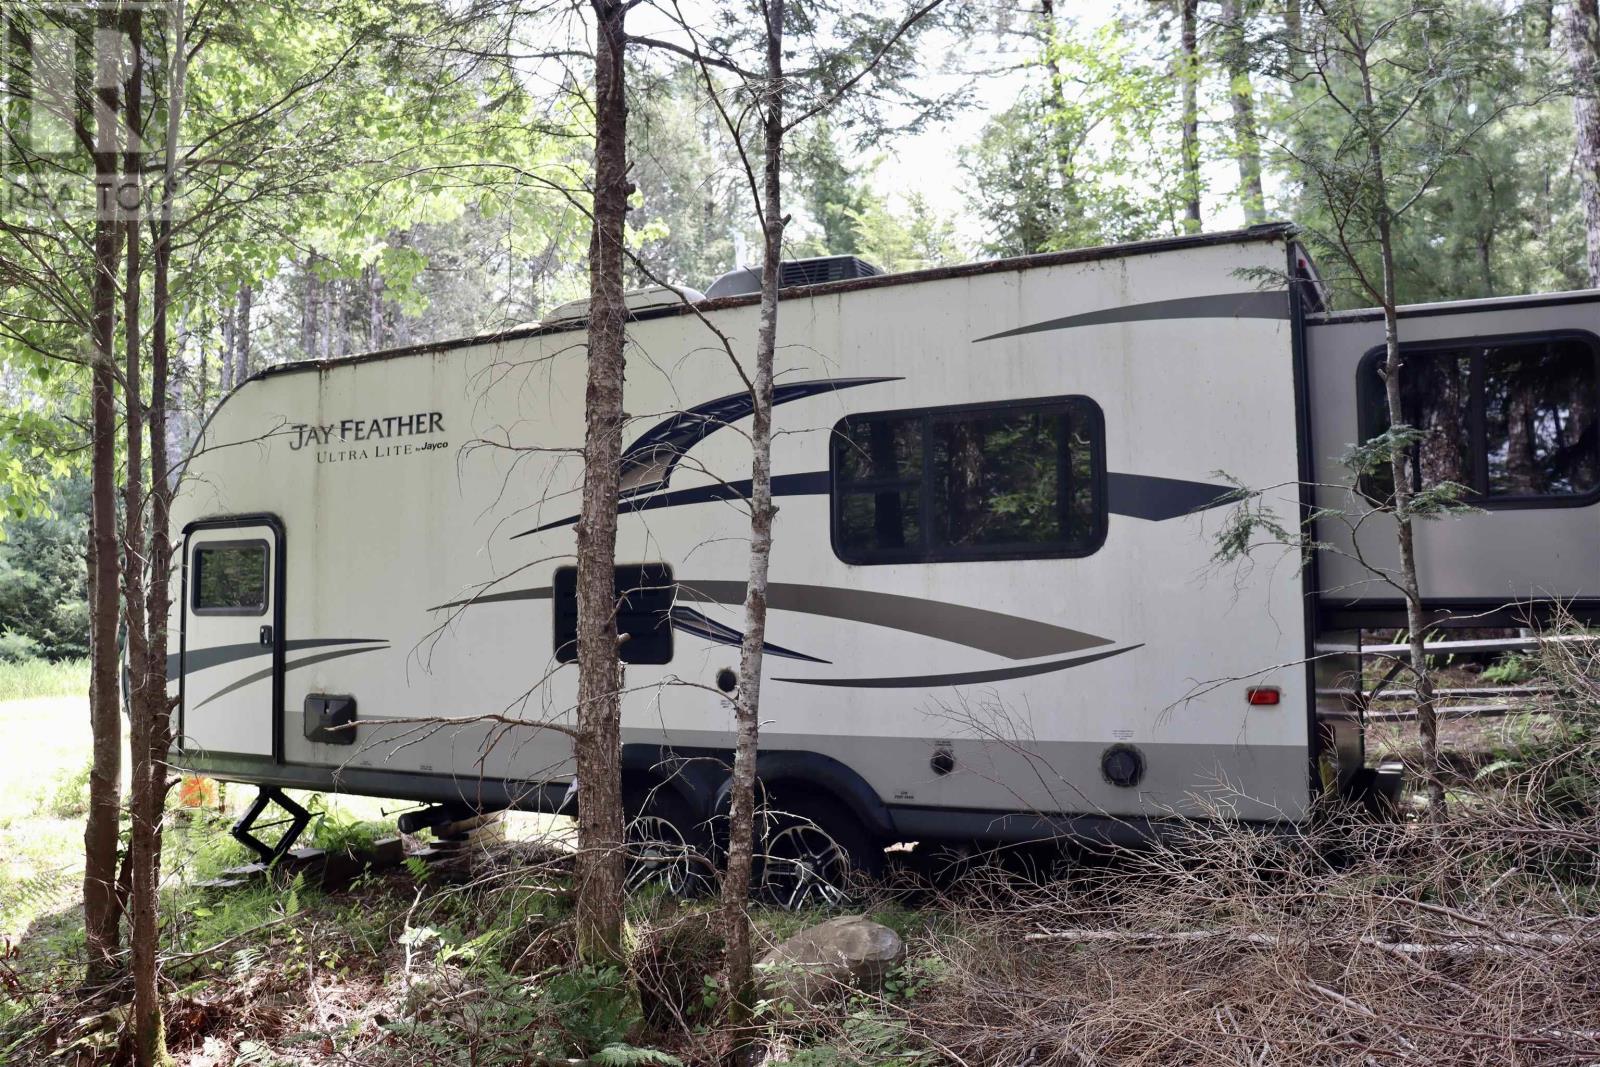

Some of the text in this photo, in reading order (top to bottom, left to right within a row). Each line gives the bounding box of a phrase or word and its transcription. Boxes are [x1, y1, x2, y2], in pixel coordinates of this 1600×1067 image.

[289, 411, 445, 450] JAY FEATHER
[317, 441, 449, 464] ULTRA LITE Jayco
